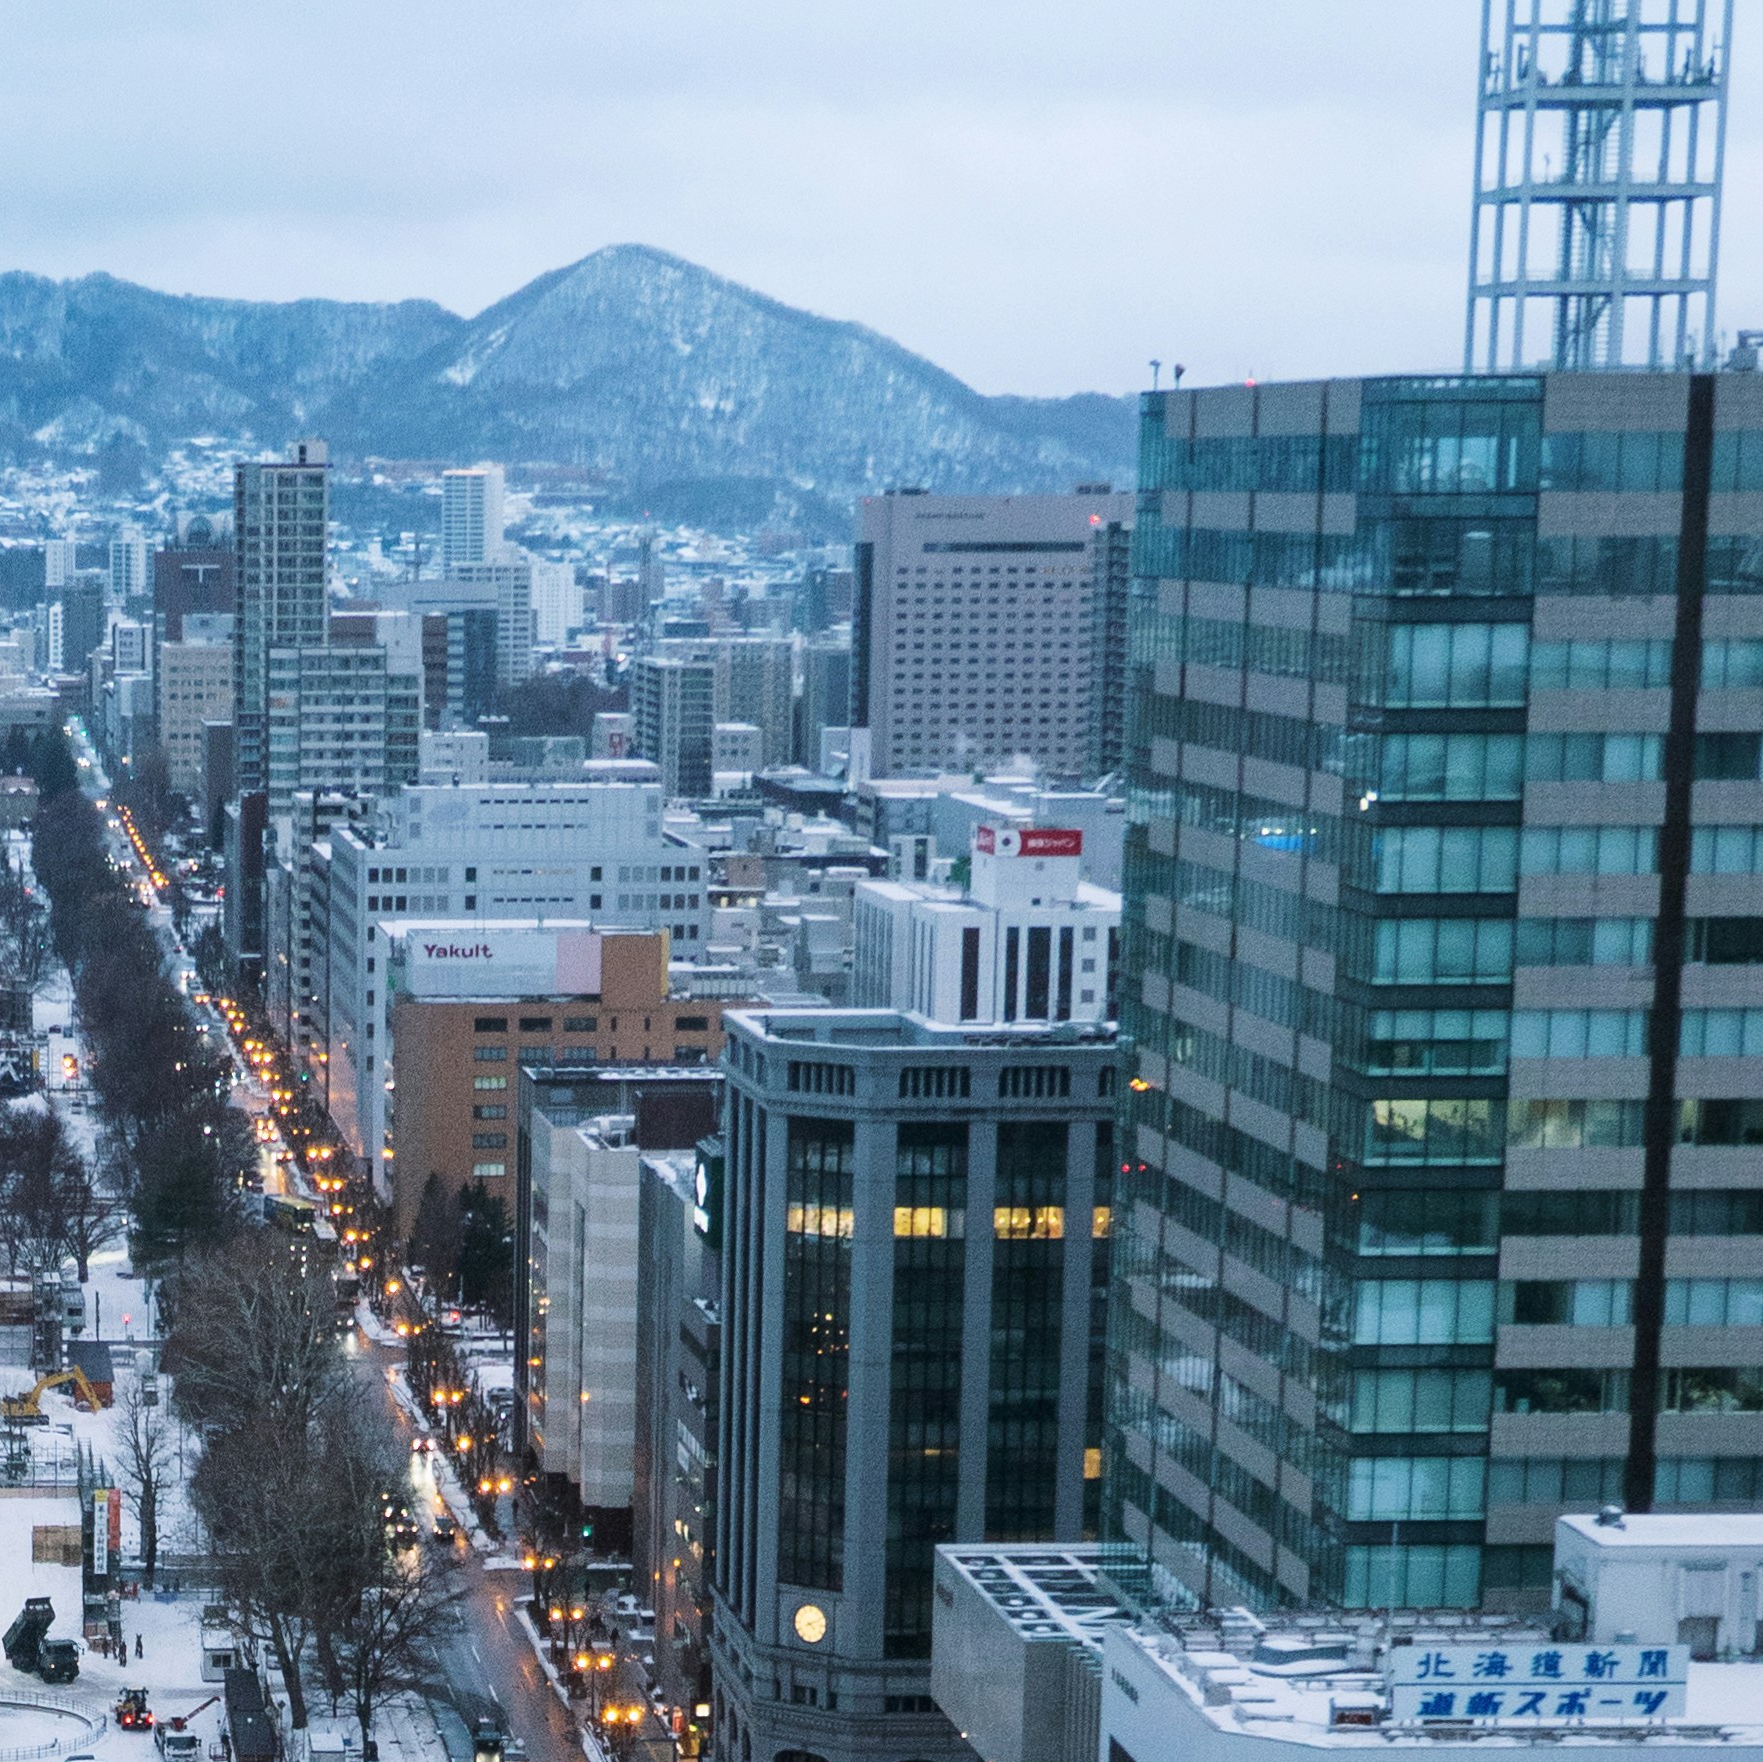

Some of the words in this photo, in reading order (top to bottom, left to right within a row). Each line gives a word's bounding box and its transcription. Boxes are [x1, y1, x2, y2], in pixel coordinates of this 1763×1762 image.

[423, 944, 493, 958] Yakult
[1416, 1650, 1668, 1678] 北海道新聞
[1416, 1688, 1668, 1716] 道新スポーツ
